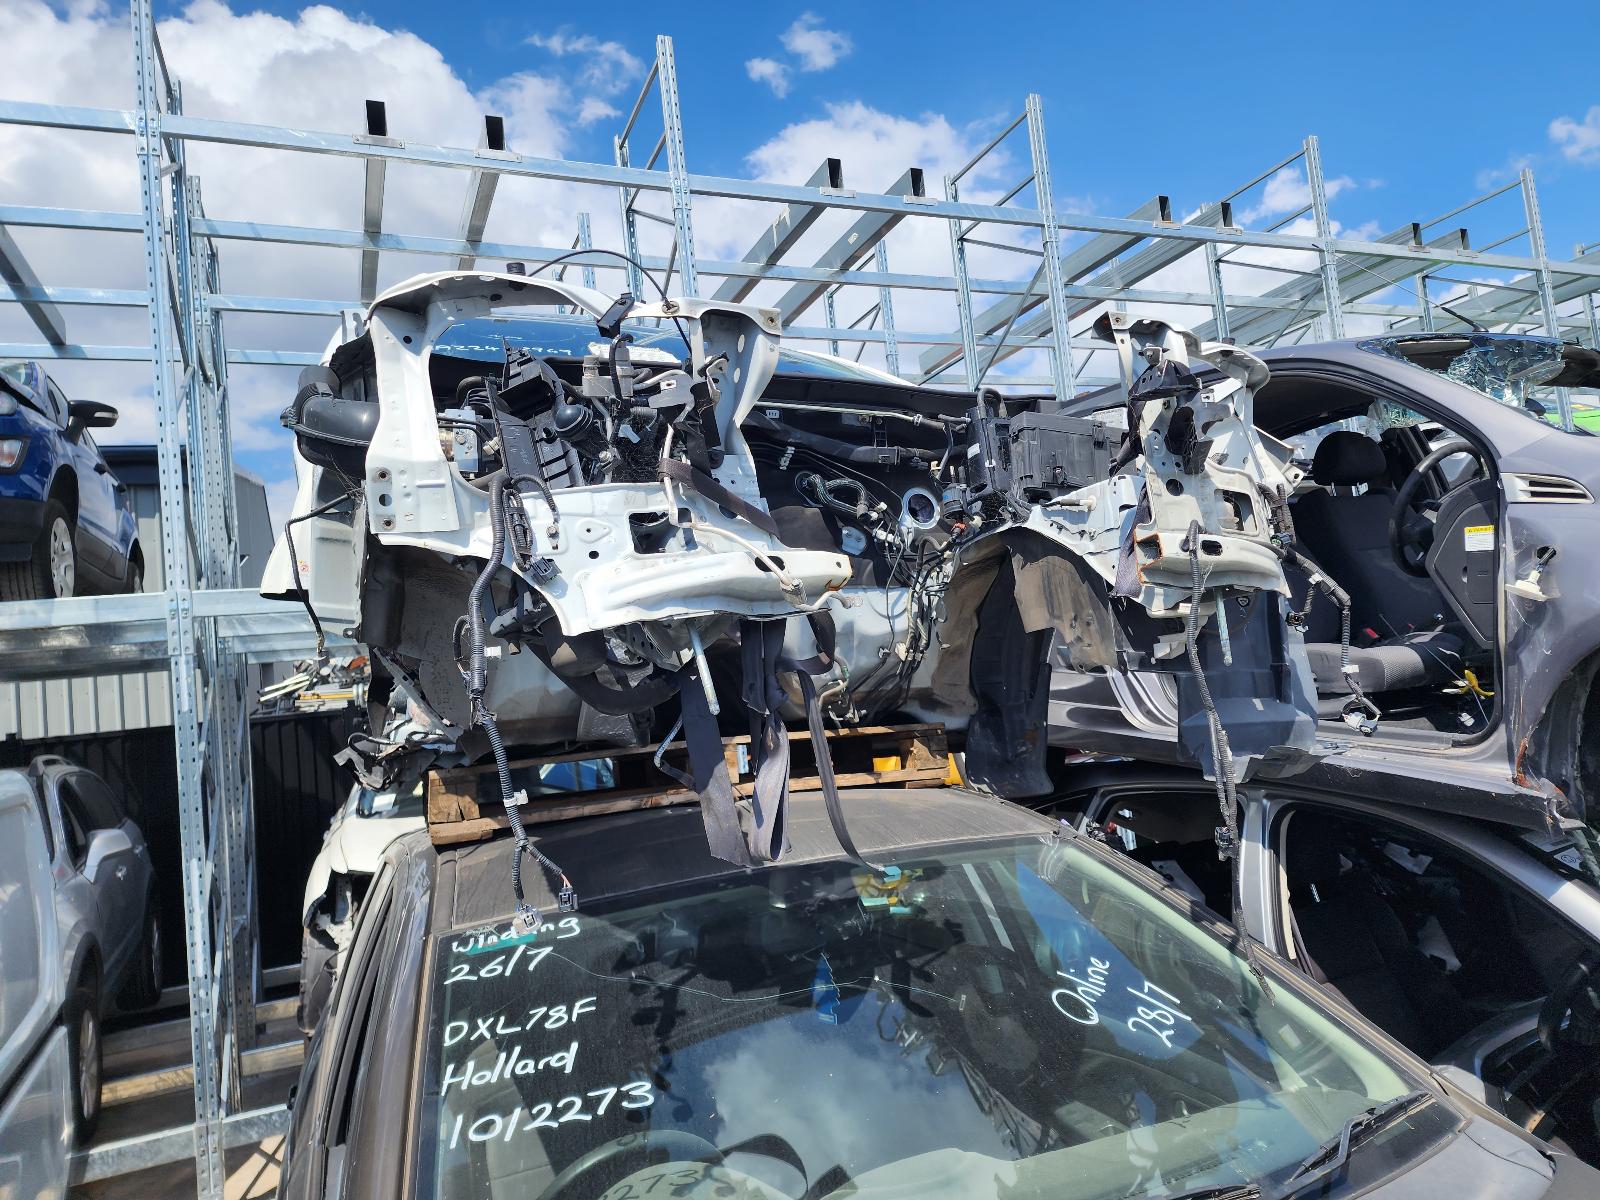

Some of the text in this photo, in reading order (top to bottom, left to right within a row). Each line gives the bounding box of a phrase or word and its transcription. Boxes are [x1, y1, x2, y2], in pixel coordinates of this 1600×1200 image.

[451, 916, 581, 953] windng
[443, 944, 554, 985] 26/7
[1051, 956, 1110, 1025] Online
[443, 996, 597, 1047] DXL78F
[1126, 979, 1193, 1048] 28/7
[441, 1041, 579, 1097] Hollard
[449, 1080, 655, 1150] 1012273
